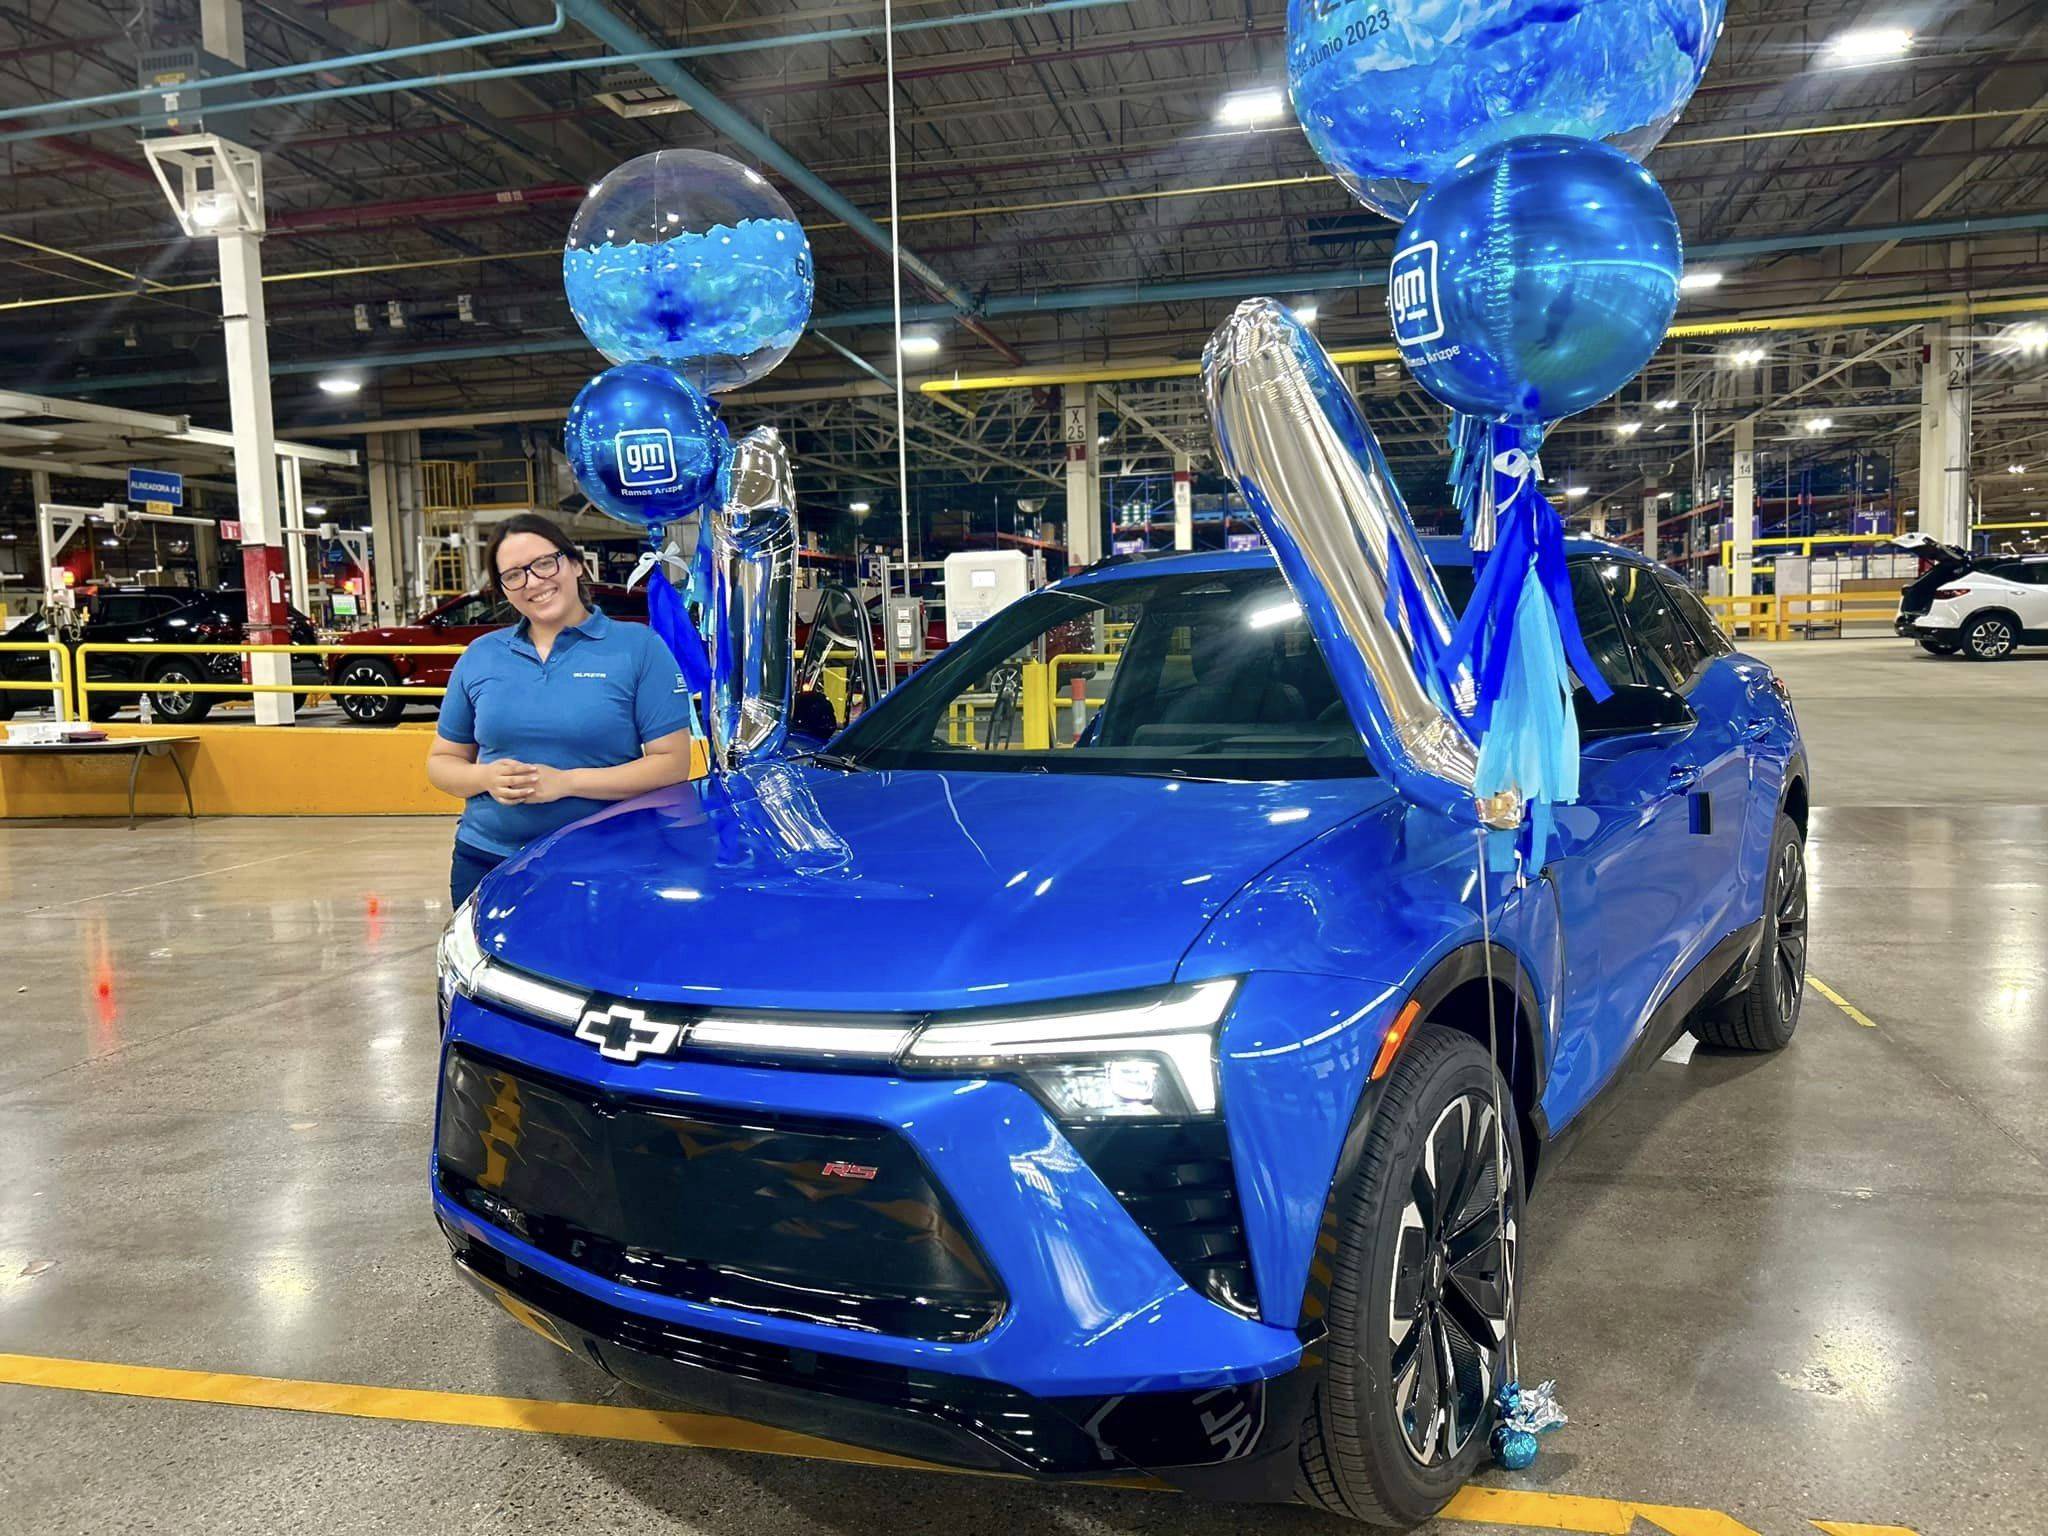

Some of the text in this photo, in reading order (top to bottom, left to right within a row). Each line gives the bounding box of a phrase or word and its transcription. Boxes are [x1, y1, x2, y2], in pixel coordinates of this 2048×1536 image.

[1345, 9, 1390, 46] 2023
[1427, 344, 1461, 364] Arizpe
[1955, 352, 1965, 367] X
[1072, 409, 1080, 424] X
[1067, 425, 1084, 440] 25
[621, 488, 653, 496] Ramos
[821, 1161, 878, 1180] RS
